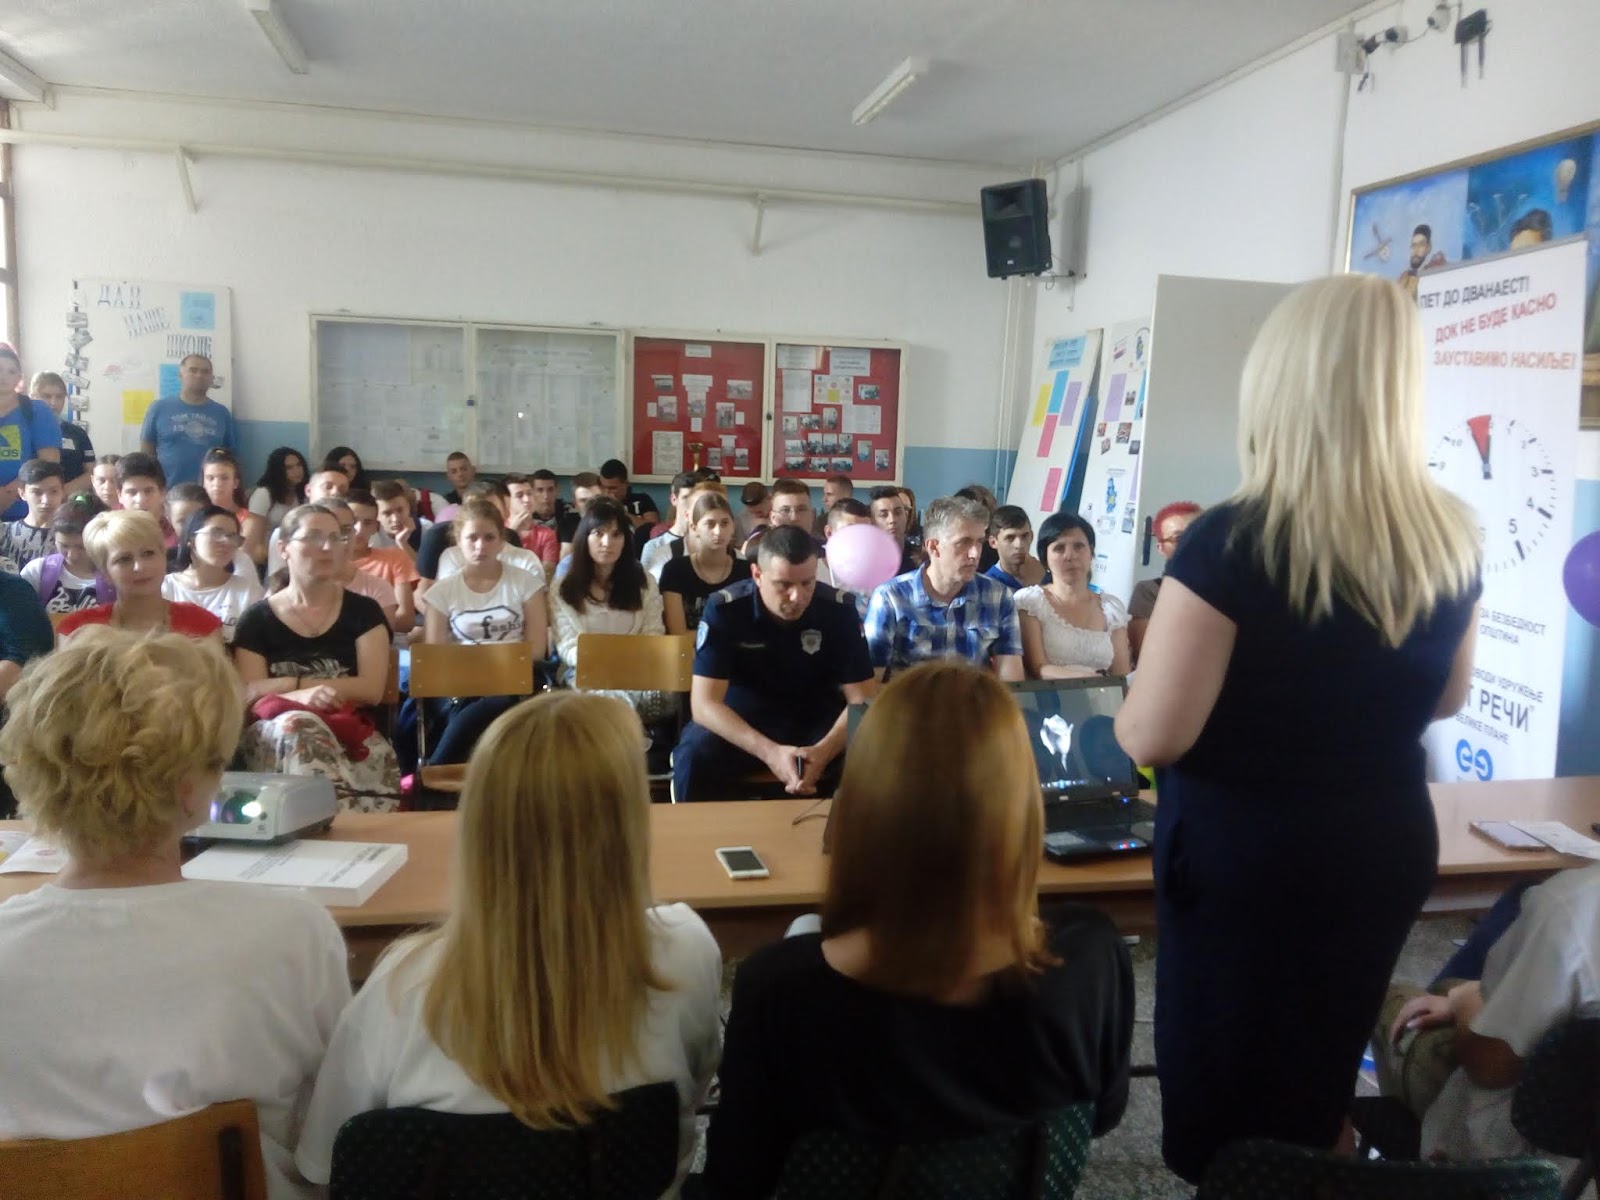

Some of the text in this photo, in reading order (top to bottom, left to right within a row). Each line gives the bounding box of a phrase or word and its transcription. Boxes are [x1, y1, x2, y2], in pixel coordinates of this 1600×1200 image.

[1443, 288, 1459, 308] ДО
[1461, 275, 1530, 305] ДВАНАЕСТ!
[1435, 292, 1557, 344] ДОК НЕ БУДЕ КАСНО
[1434, 350, 1577, 370] ЗАУСТАВИМО НАСИЉЕ!
[1531, 466, 1539, 477] 3
[1526, 496, 1535, 509] 4
[1508, 518, 1518, 534] 5
